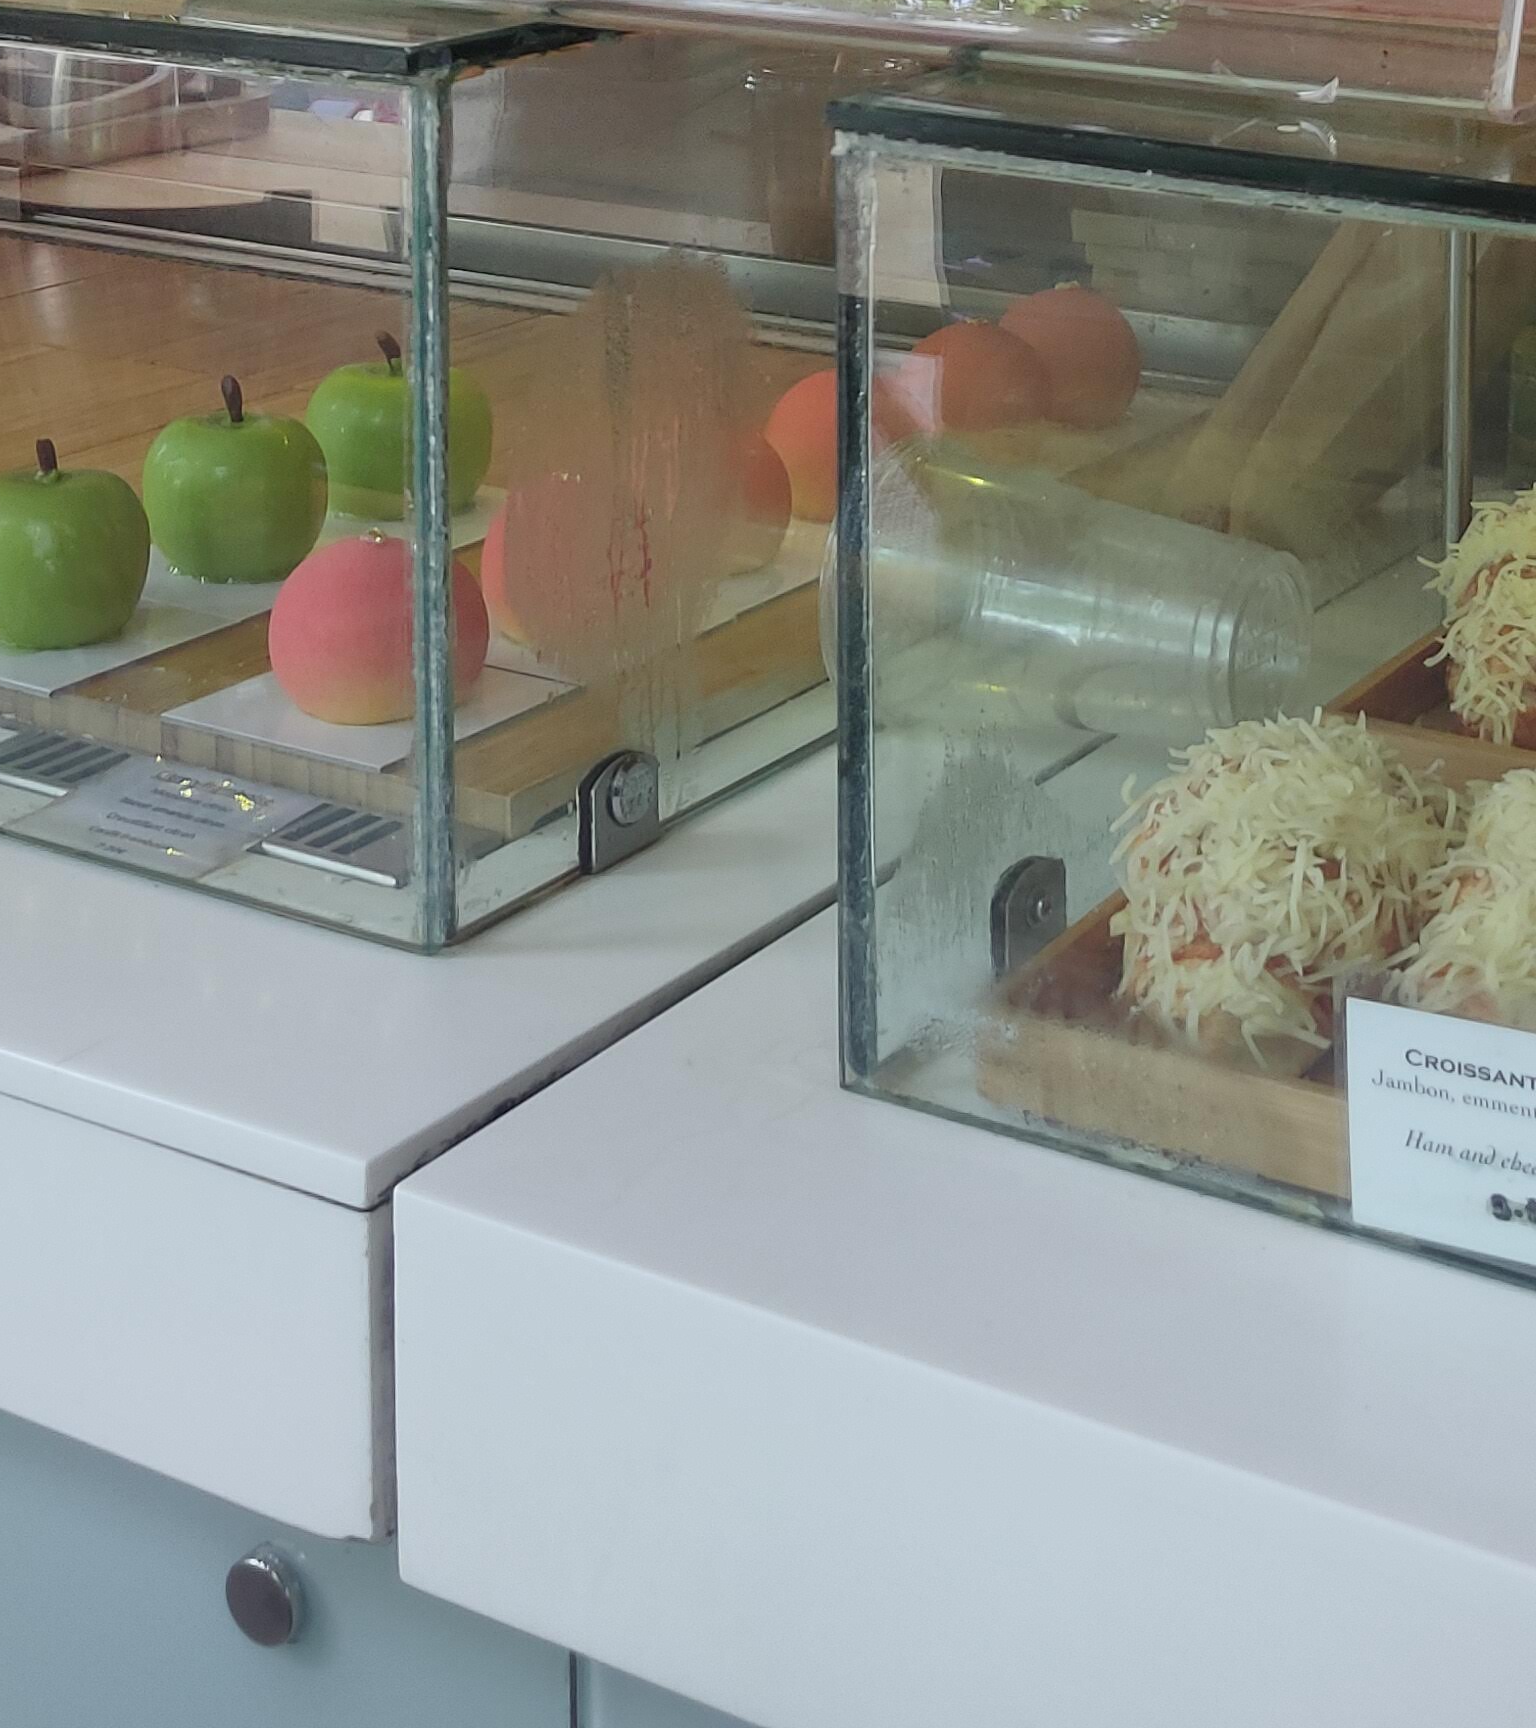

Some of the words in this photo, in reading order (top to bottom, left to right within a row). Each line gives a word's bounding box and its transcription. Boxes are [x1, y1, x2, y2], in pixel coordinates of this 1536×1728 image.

[1371, 1069, 1456, 1104] Jambon,
[1404, 1128, 1454, 1159] Ham
[1458, 1144, 1497, 1167] and
